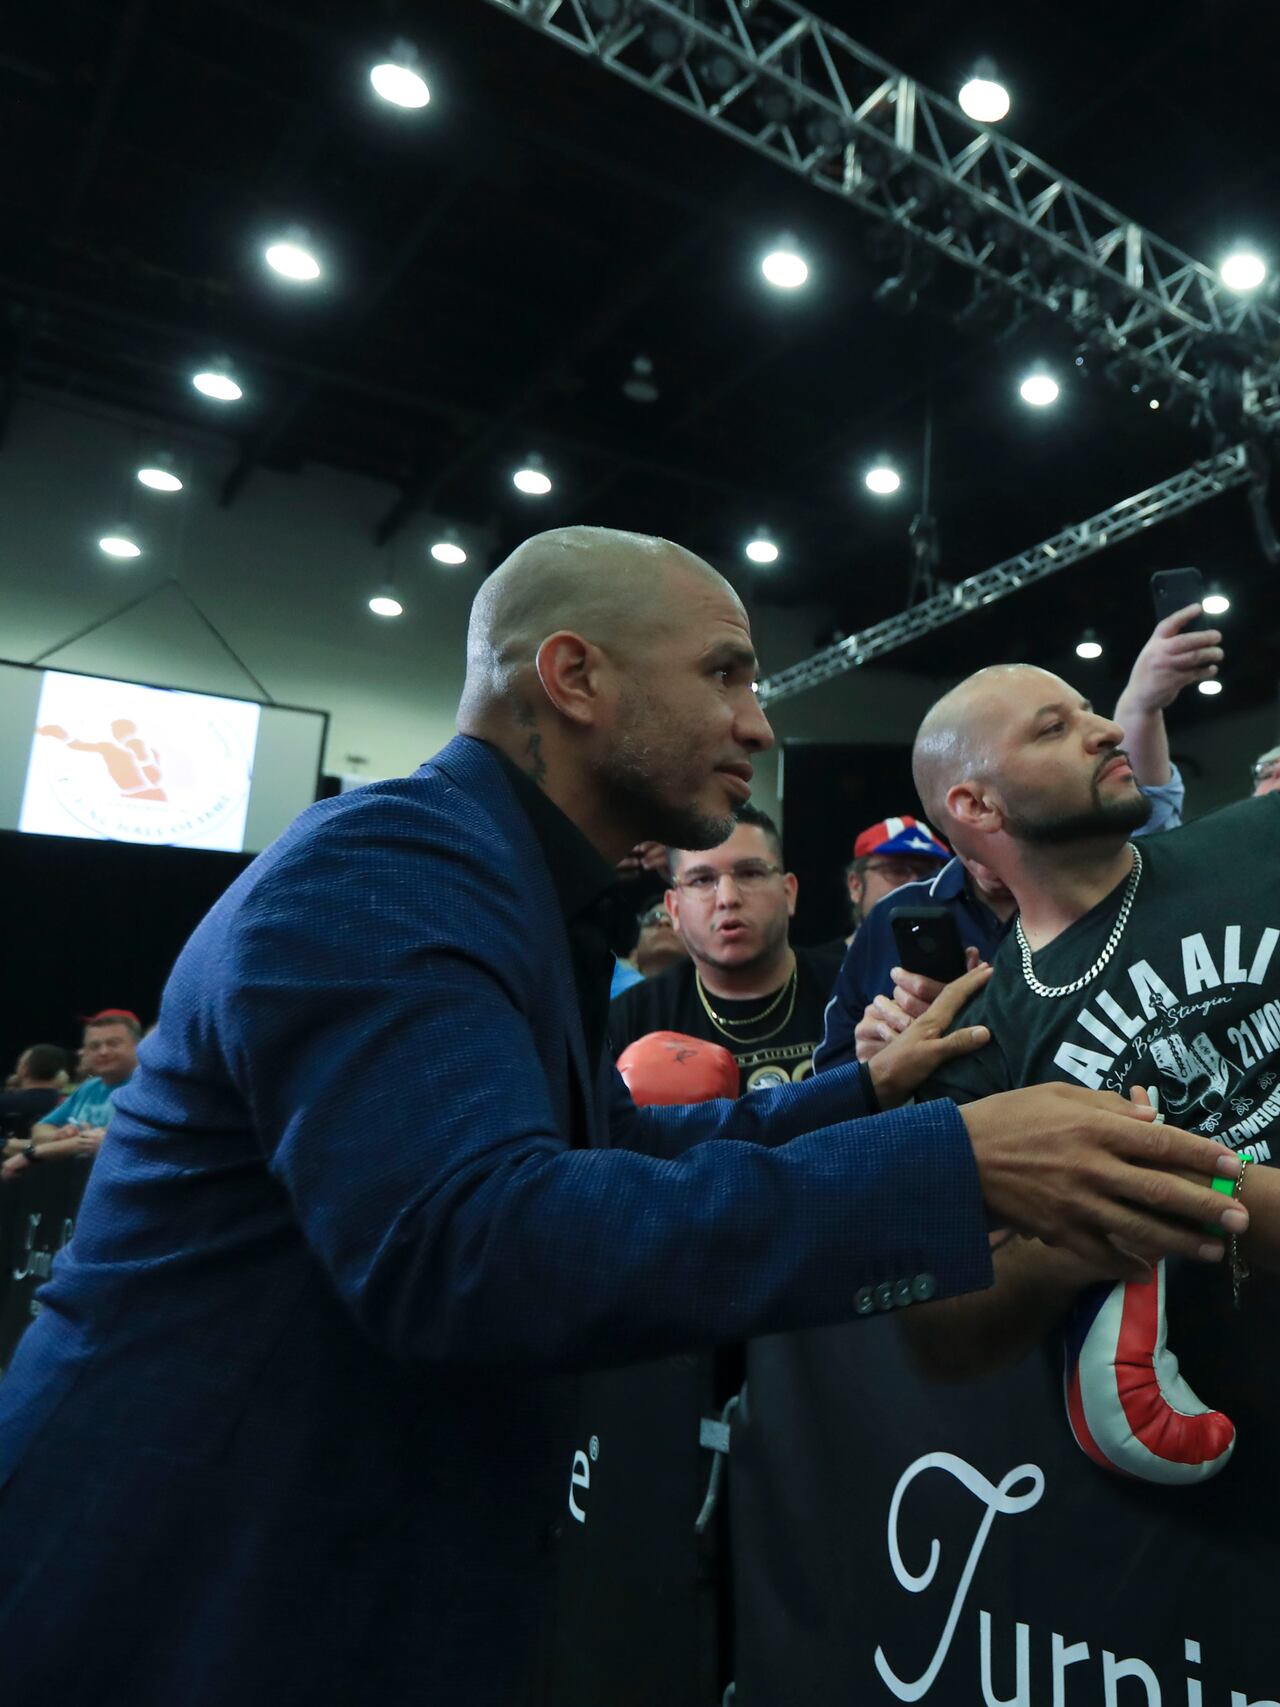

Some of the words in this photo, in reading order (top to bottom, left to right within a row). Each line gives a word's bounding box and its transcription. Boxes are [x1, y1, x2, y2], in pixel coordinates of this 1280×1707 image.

[1053, 959, 1179, 1091] AILA
[1181, 925, 1280, 995] ALI
[1106, 1060, 1132, 1095] She
[1132, 1025, 1163, 1059] Bee
[1227, 1020, 1264, 1069] 21
[1237, 1140, 1272, 1165] ON
